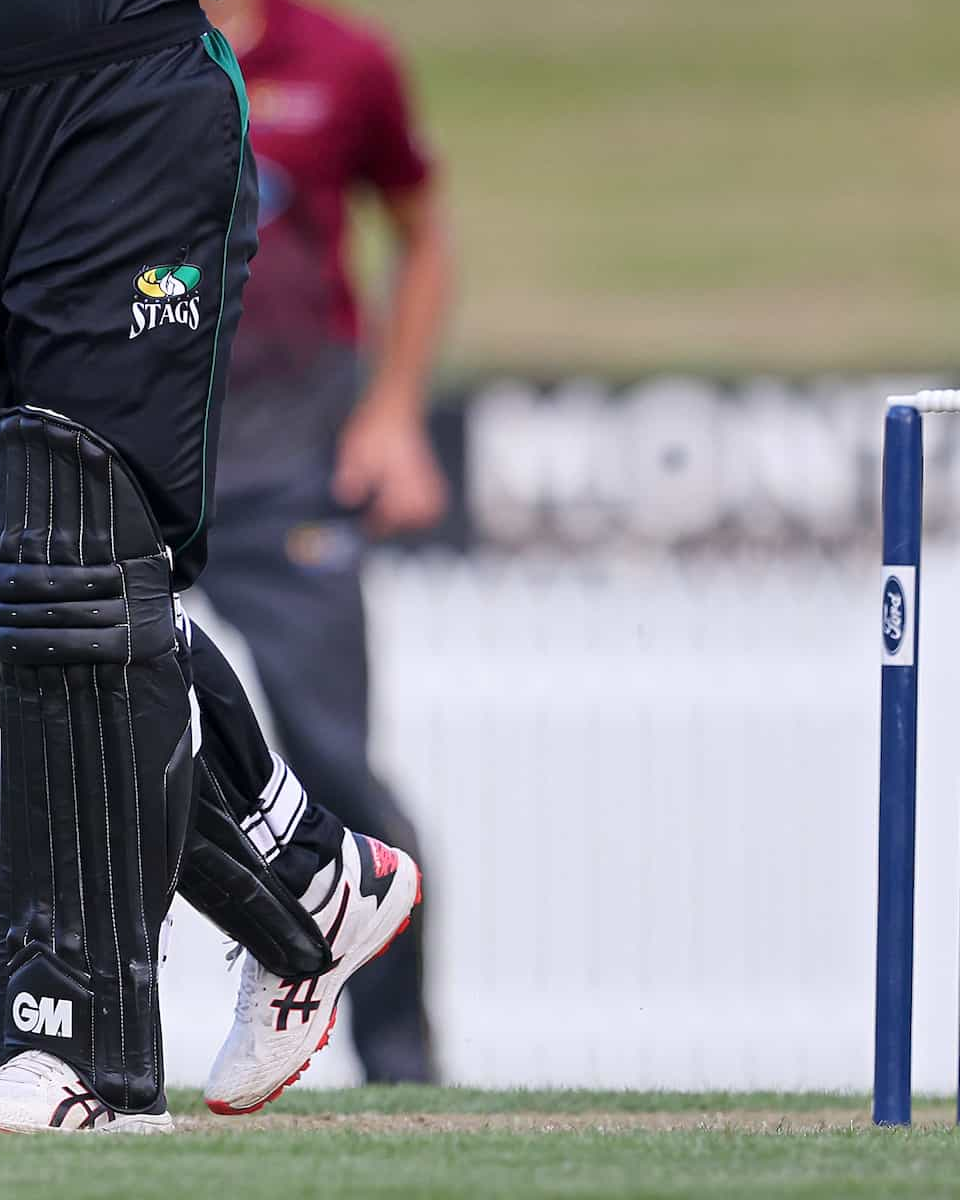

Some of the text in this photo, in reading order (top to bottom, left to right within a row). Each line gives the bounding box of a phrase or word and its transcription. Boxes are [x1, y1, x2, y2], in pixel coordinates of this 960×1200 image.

[128, 296, 200, 340] STAGS
[883, 591, 902, 640] Ford
[12, 991, 73, 1039] GM
